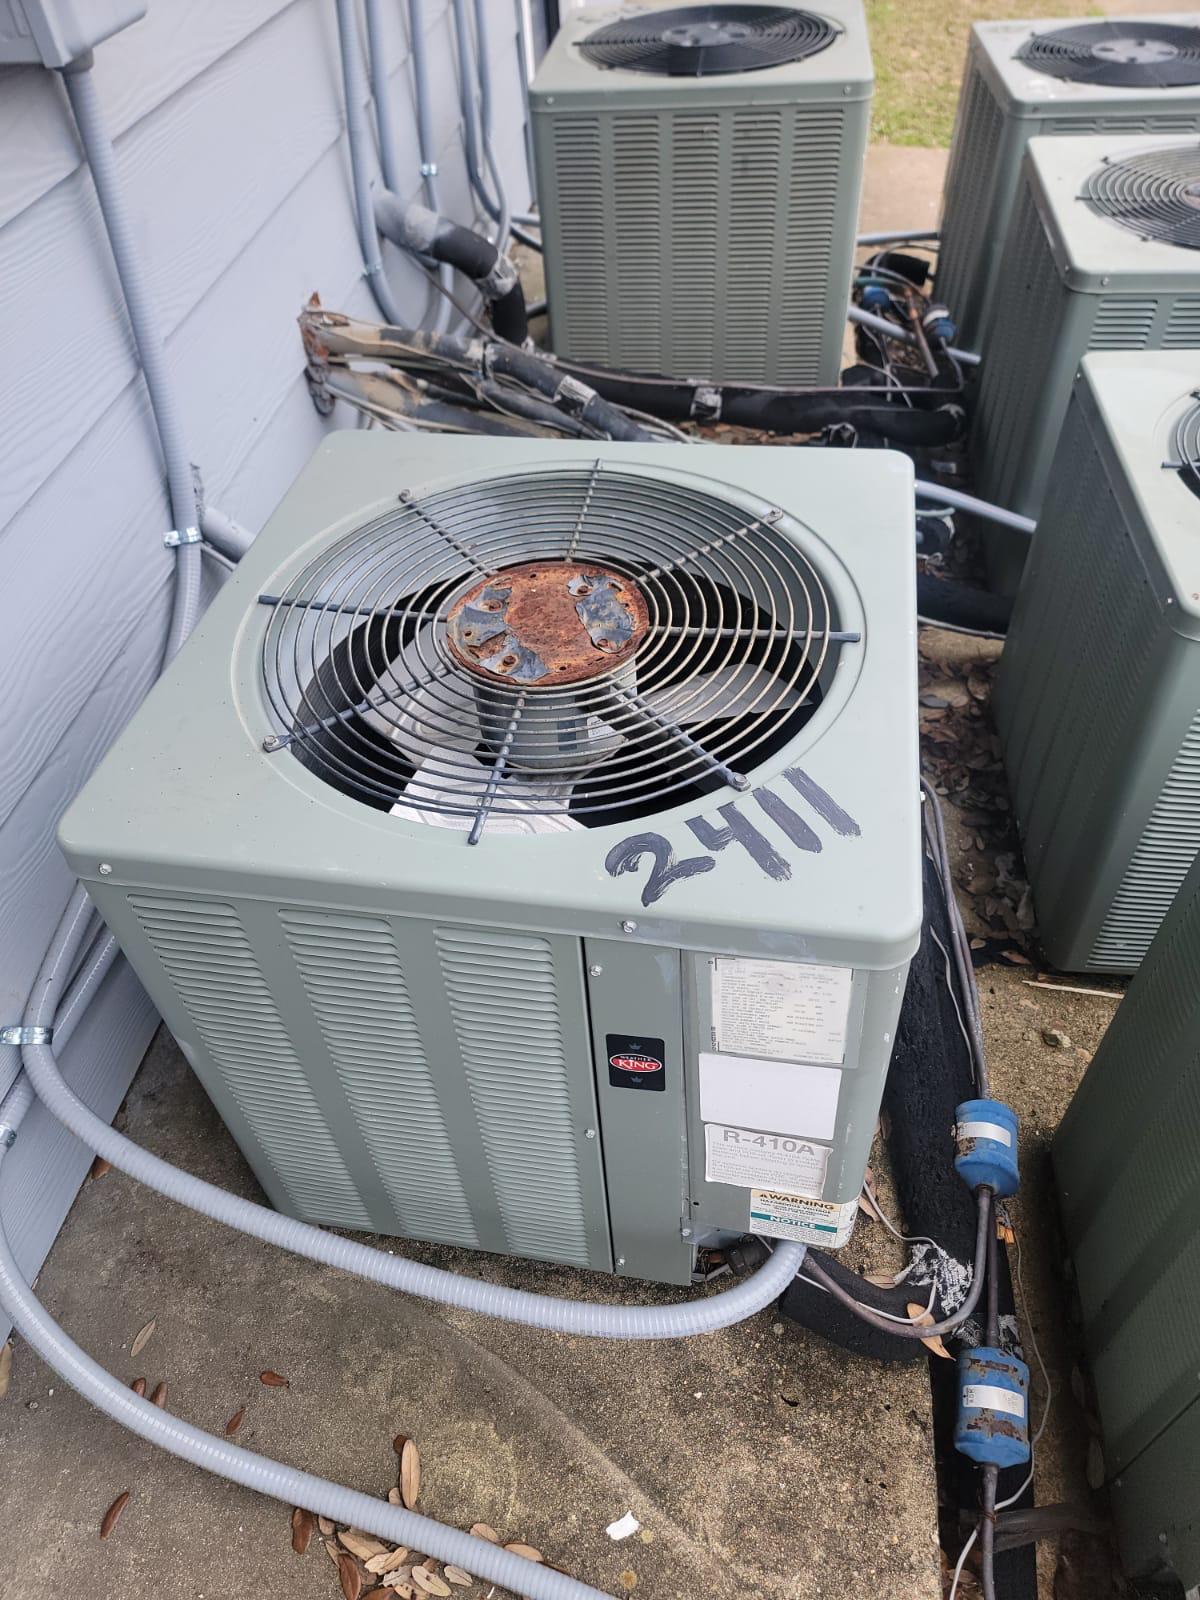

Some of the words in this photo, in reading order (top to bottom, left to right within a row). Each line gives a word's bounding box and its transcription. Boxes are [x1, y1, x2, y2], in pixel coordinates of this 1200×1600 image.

[605, 767, 861, 907] 2411
[619, 1059, 658, 1070] KING
[723, 1129, 815, 1156] R-410A
[769, 1193, 834, 1210] WARNING
[770, 1215, 817, 1230] NOTICE
